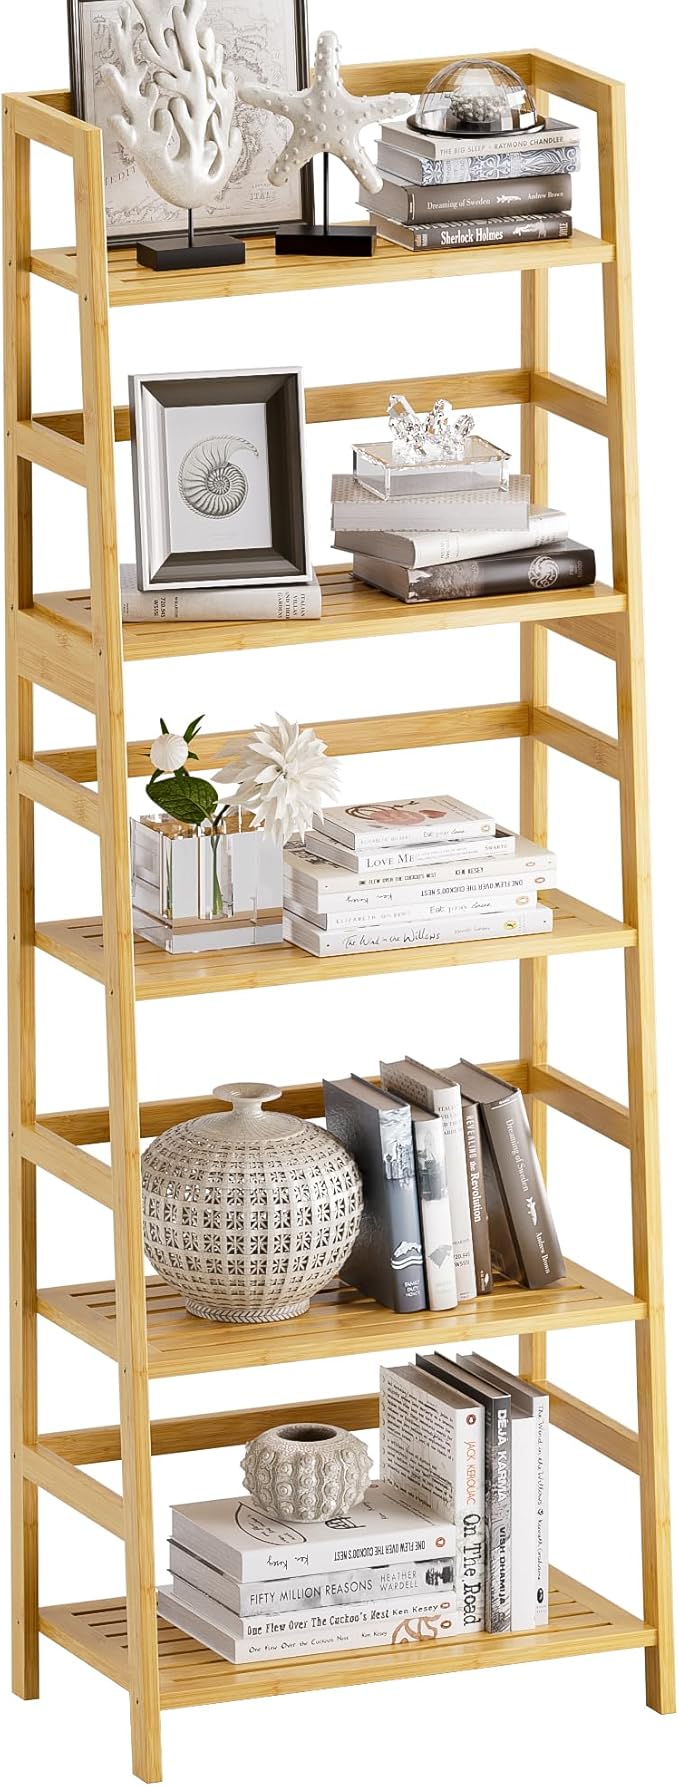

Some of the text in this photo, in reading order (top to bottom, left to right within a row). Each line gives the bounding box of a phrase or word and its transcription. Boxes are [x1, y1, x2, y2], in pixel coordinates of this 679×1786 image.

[440, 148, 452, 156] THE
[467, 144, 485, 153] SLEEP
[494, 141, 528, 149] RAYMOND
[529, 136, 564, 146] CHANDLER
[427, 201, 458, 210] Dreaming
[459, 199, 466, 207] of
[466, 198, 491, 206] Sweden
[440, 229, 474, 245] Sherlock
[475, 227, 503, 242] Holmes
[367, 855, 394, 868] LOVE
[398, 853, 415, 864] ME
[467, 867, 484, 875] KESEY
[495, 881, 511, 889] FLEW
[420, 889, 436, 897] NEST
[470, 1172, 482, 1222] Revolution
[505, 1119, 552, 1274] Dreaming of Sweden Andrew Brown
[464, 1441, 477, 1505] JACK KEROUAC
[497, 1450, 508, 1502] KARMA
[374, 1545, 384, 1556] THE
[385, 1544, 399, 1555] OVER
[399, 1542, 414, 1552] FLEW
[415, 1541, 426, 1551] ONE
[333, 1551, 348, 1562] NEST
[380, 1570, 417, 1583] HEATHER
[463, 1514, 482, 1626] On The Road
[379, 1580, 418, 1592] WARDELL
[498, 1556, 506, 1605] DHAMIJA
[250, 1579, 373, 1605] FIFTY MILLION REASONS
[247, 1604, 439, 1636] One Flew Over The Cuckoo's Nest Ken Kesey
[280, 1641, 297, 1650] Over
